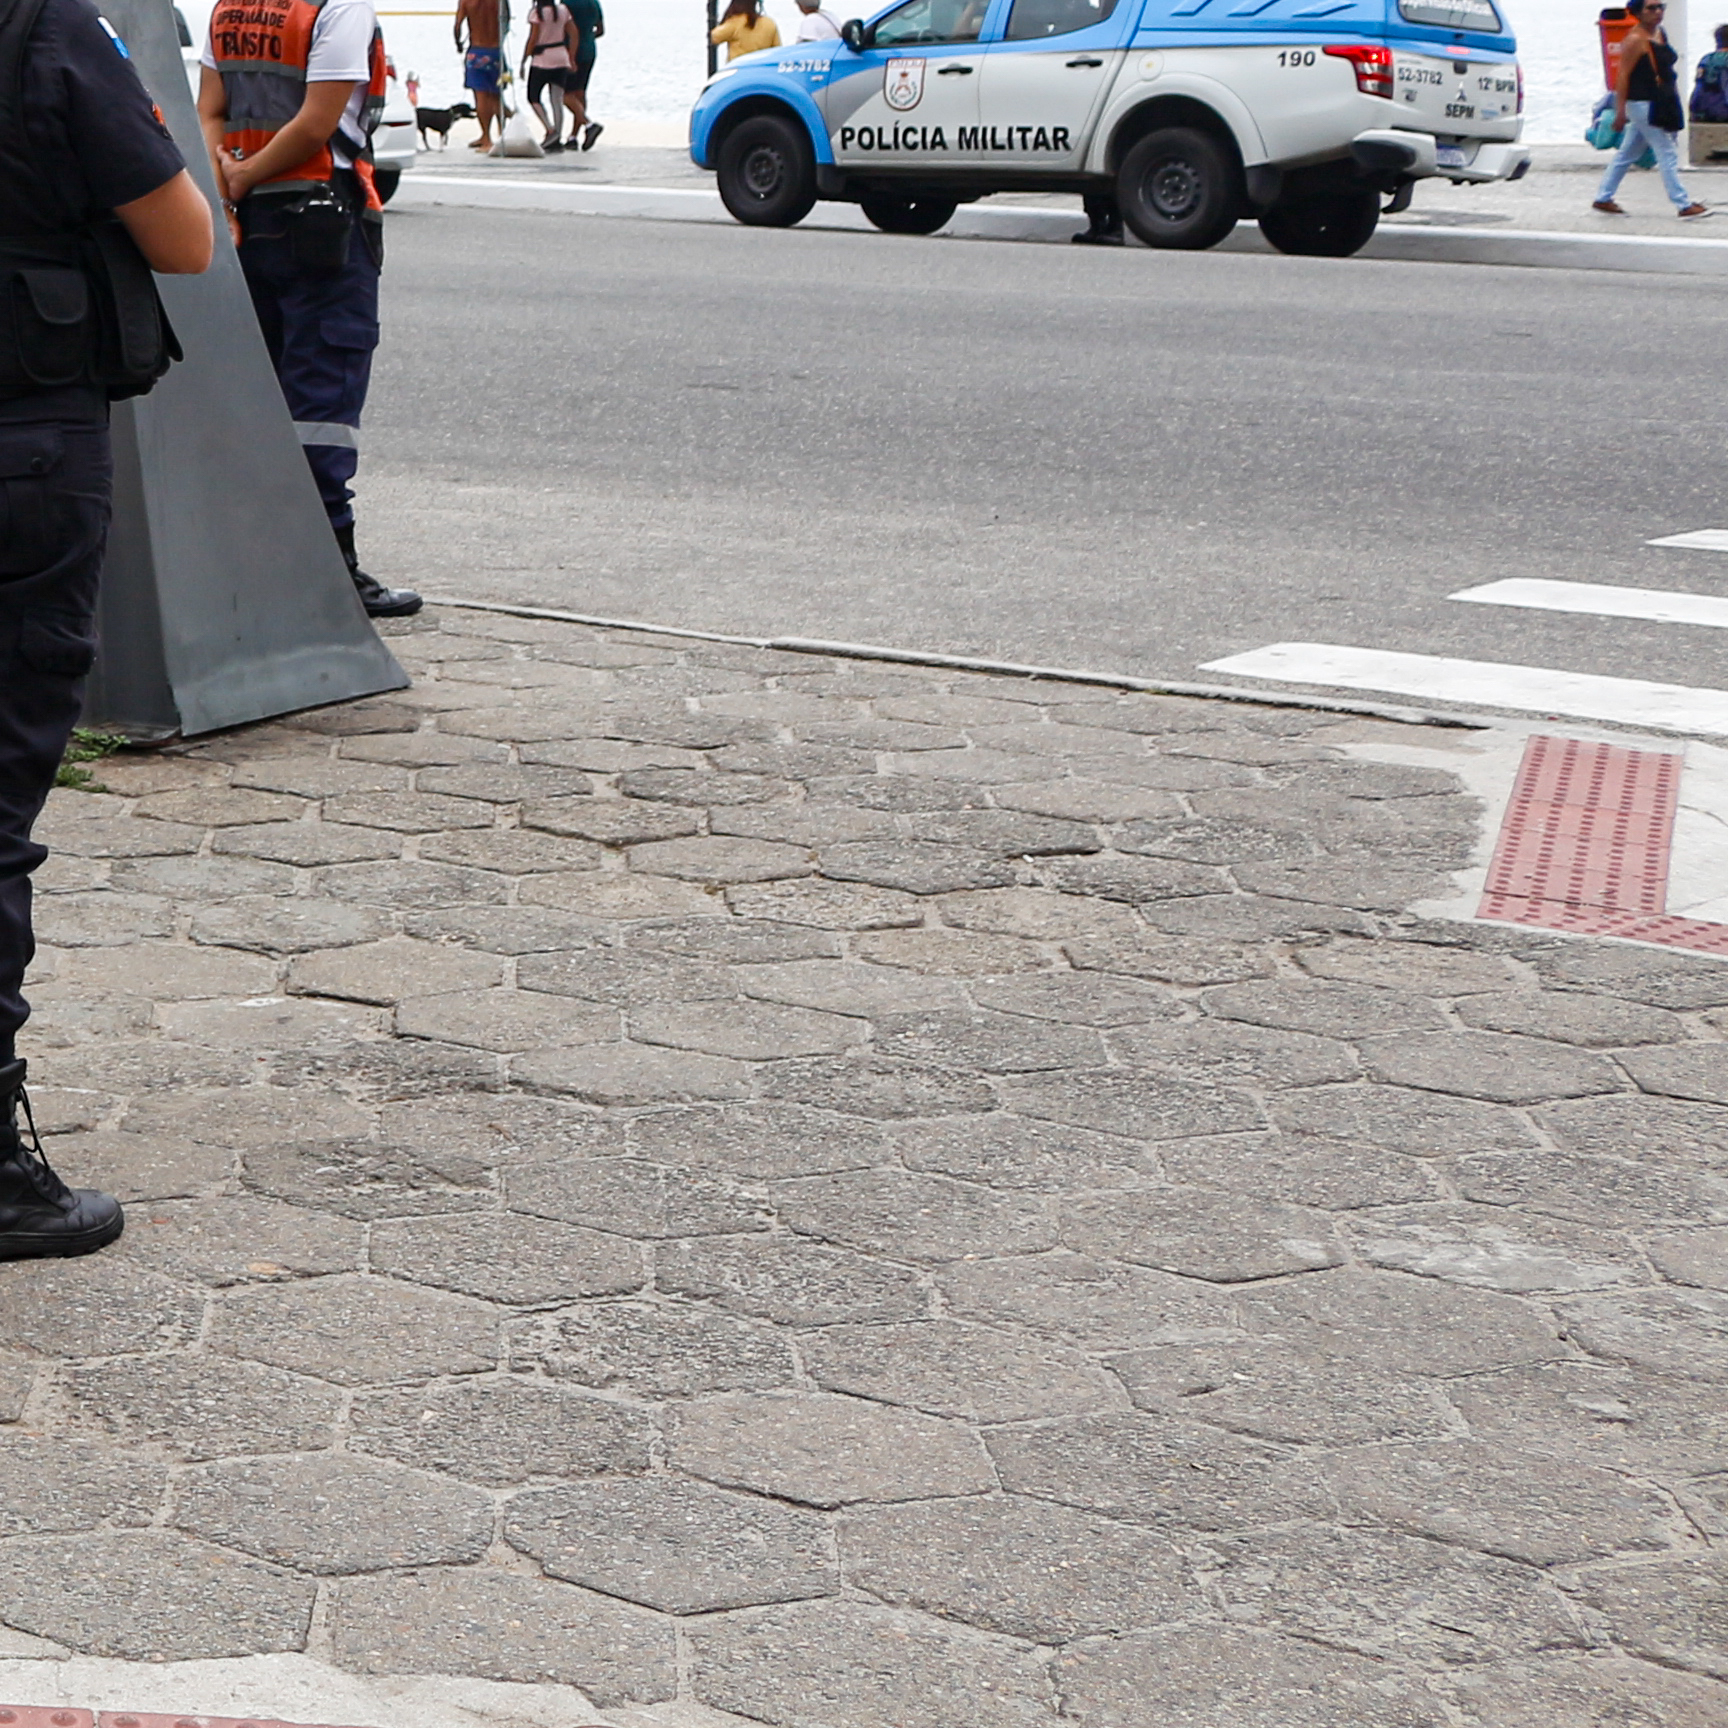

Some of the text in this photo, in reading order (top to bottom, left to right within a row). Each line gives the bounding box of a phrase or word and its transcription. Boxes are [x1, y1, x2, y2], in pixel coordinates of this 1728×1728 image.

[1277, 51, 1316, 68] 190
[1398, 66, 1443, 86] 52-3782
[1495, 80, 1516, 93] BPM
[1445, 103, 1475, 120] SEPM
[841, 119, 1072, 151] POLÍCIA MILITAR
